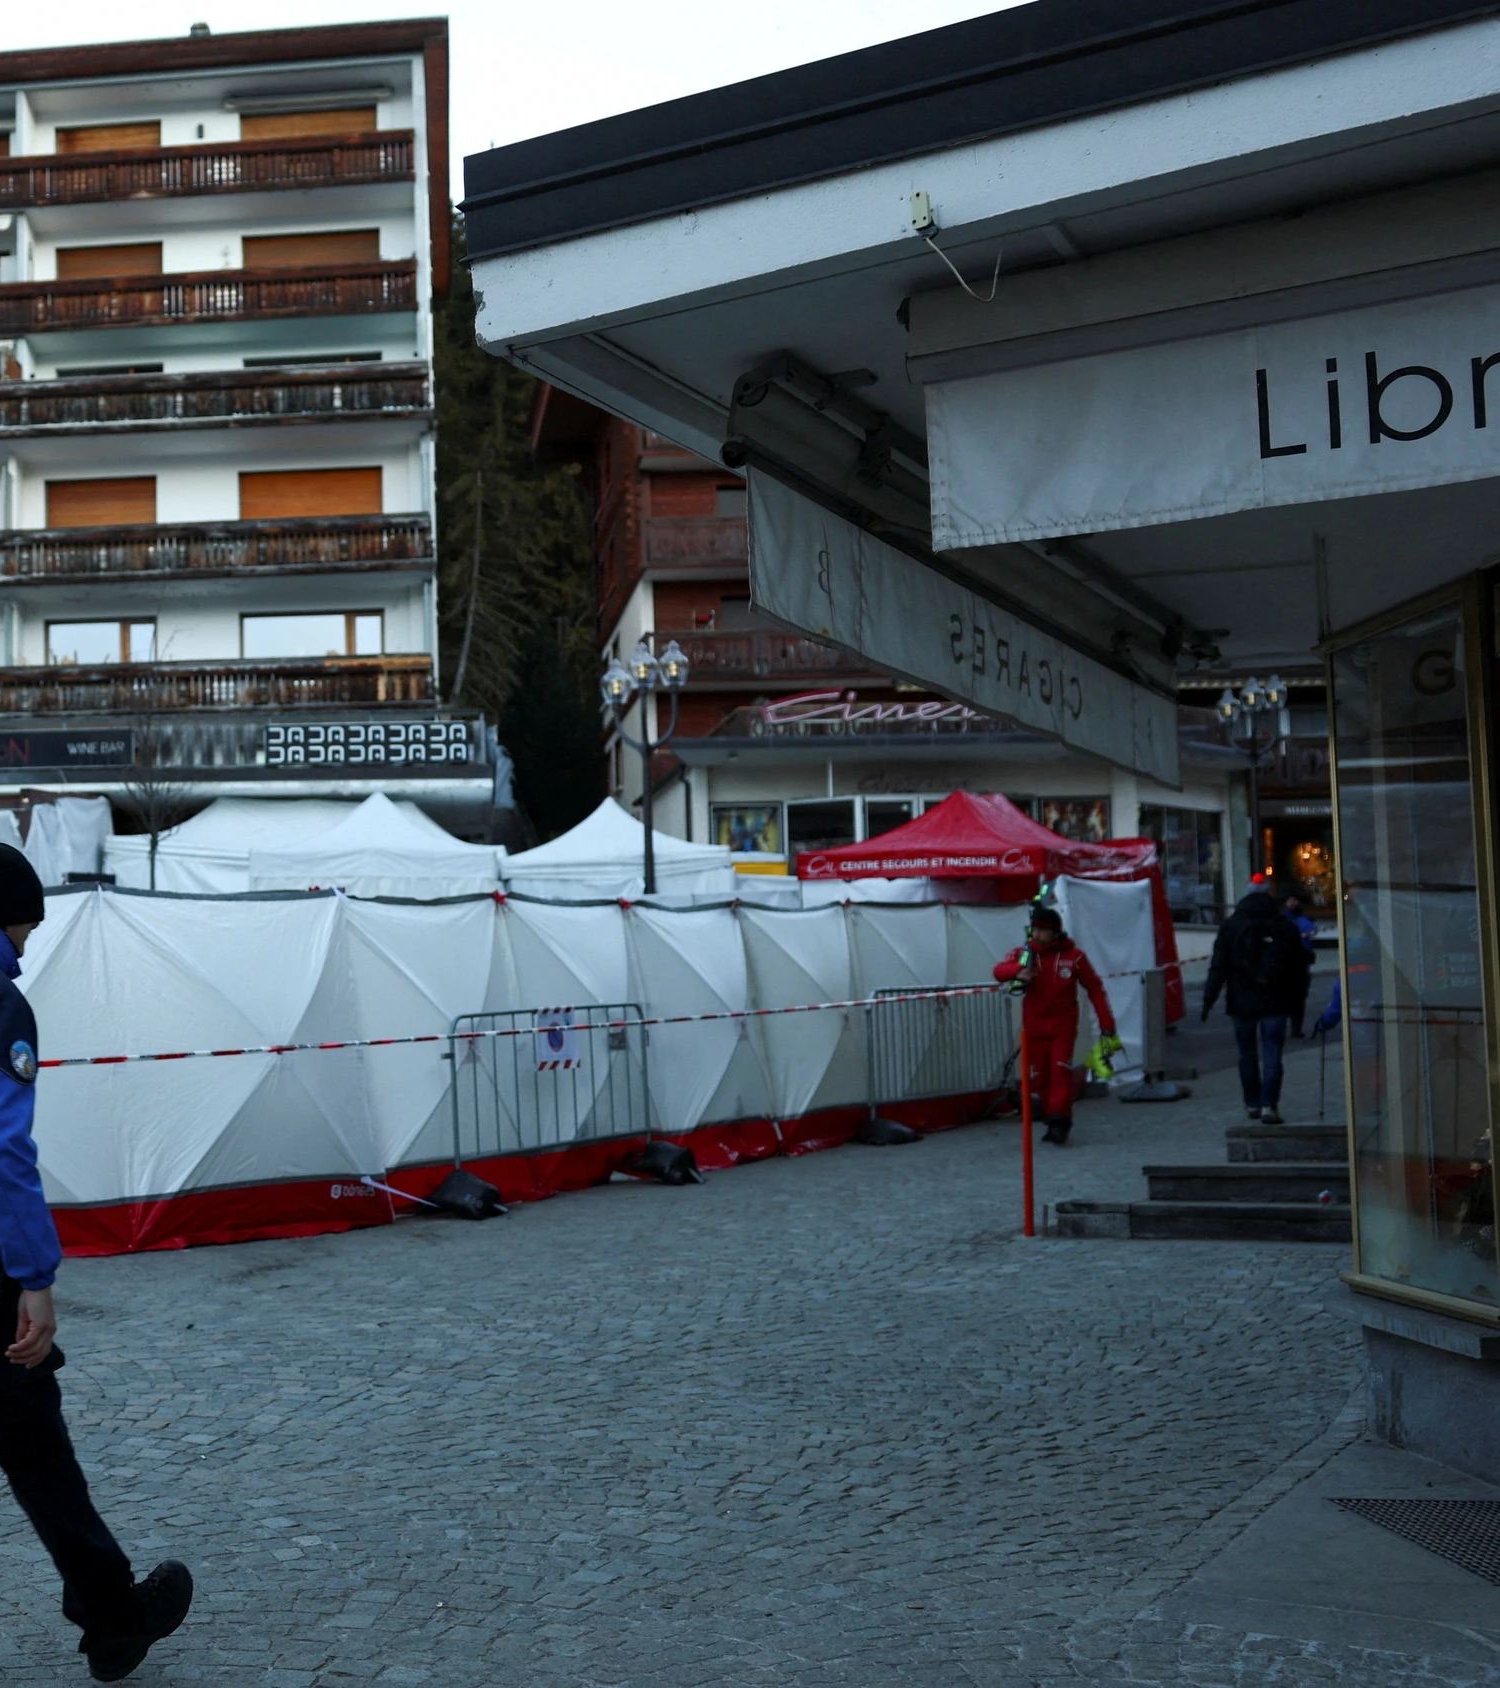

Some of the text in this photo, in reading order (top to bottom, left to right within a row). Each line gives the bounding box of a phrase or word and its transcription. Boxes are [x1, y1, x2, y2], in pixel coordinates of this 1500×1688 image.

[66, 740, 125, 755] WINE BAR
[840, 859, 880, 872] CENTRE
[882, 857, 929, 871] SECOURS
[931, 857, 945, 868] ET
[947, 855, 998, 868] INCENDIE
